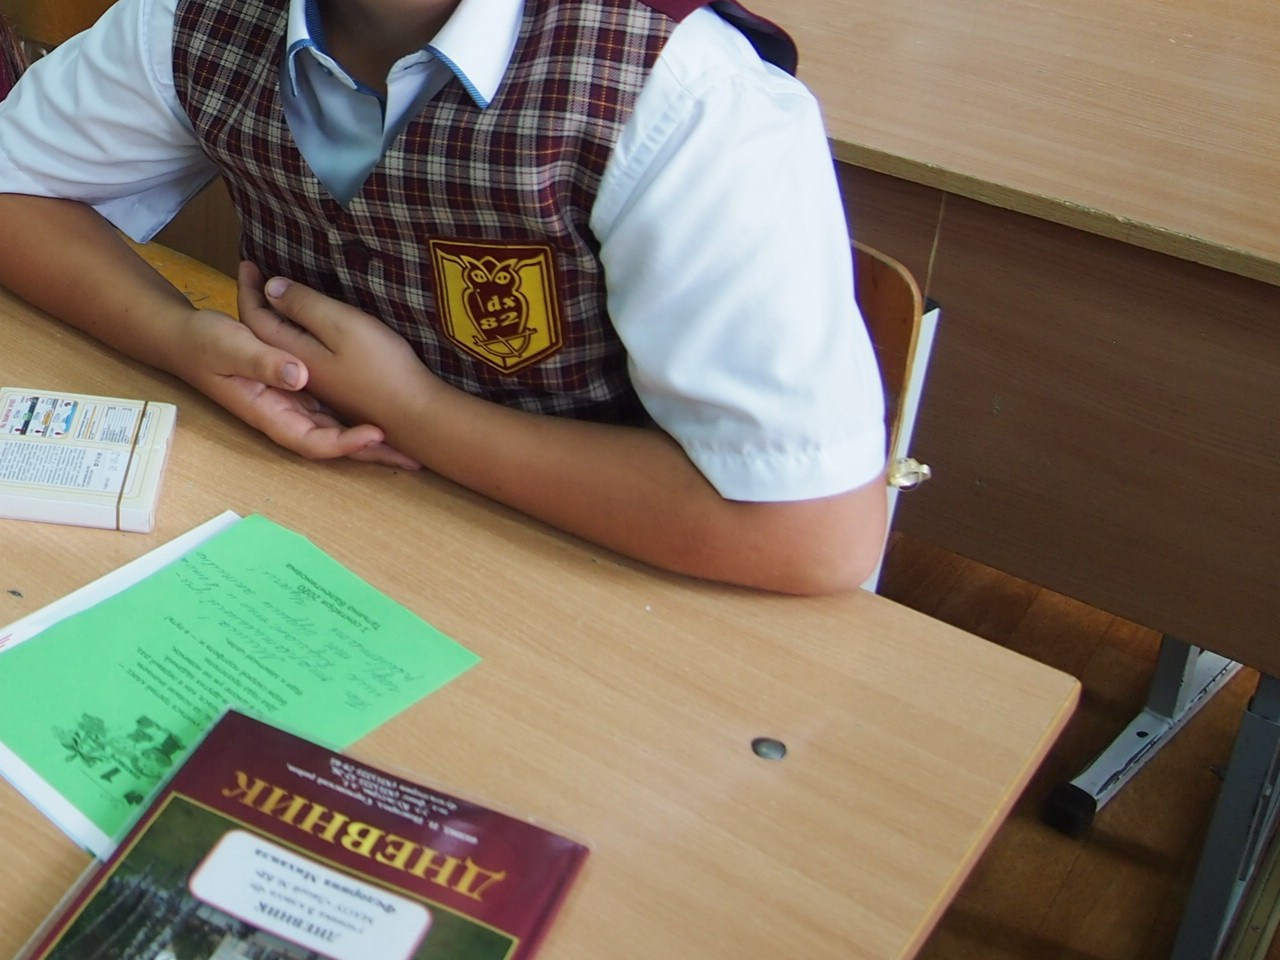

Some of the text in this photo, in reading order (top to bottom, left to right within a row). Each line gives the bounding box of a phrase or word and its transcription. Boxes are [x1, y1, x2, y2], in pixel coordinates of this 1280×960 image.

[479, 311, 520, 330] 82
[280, 562, 384, 631] Татьяна Валентиновна
[293, 583, 322, 602] 2020
[218, 769, 508, 901] ДНЕВНИК
